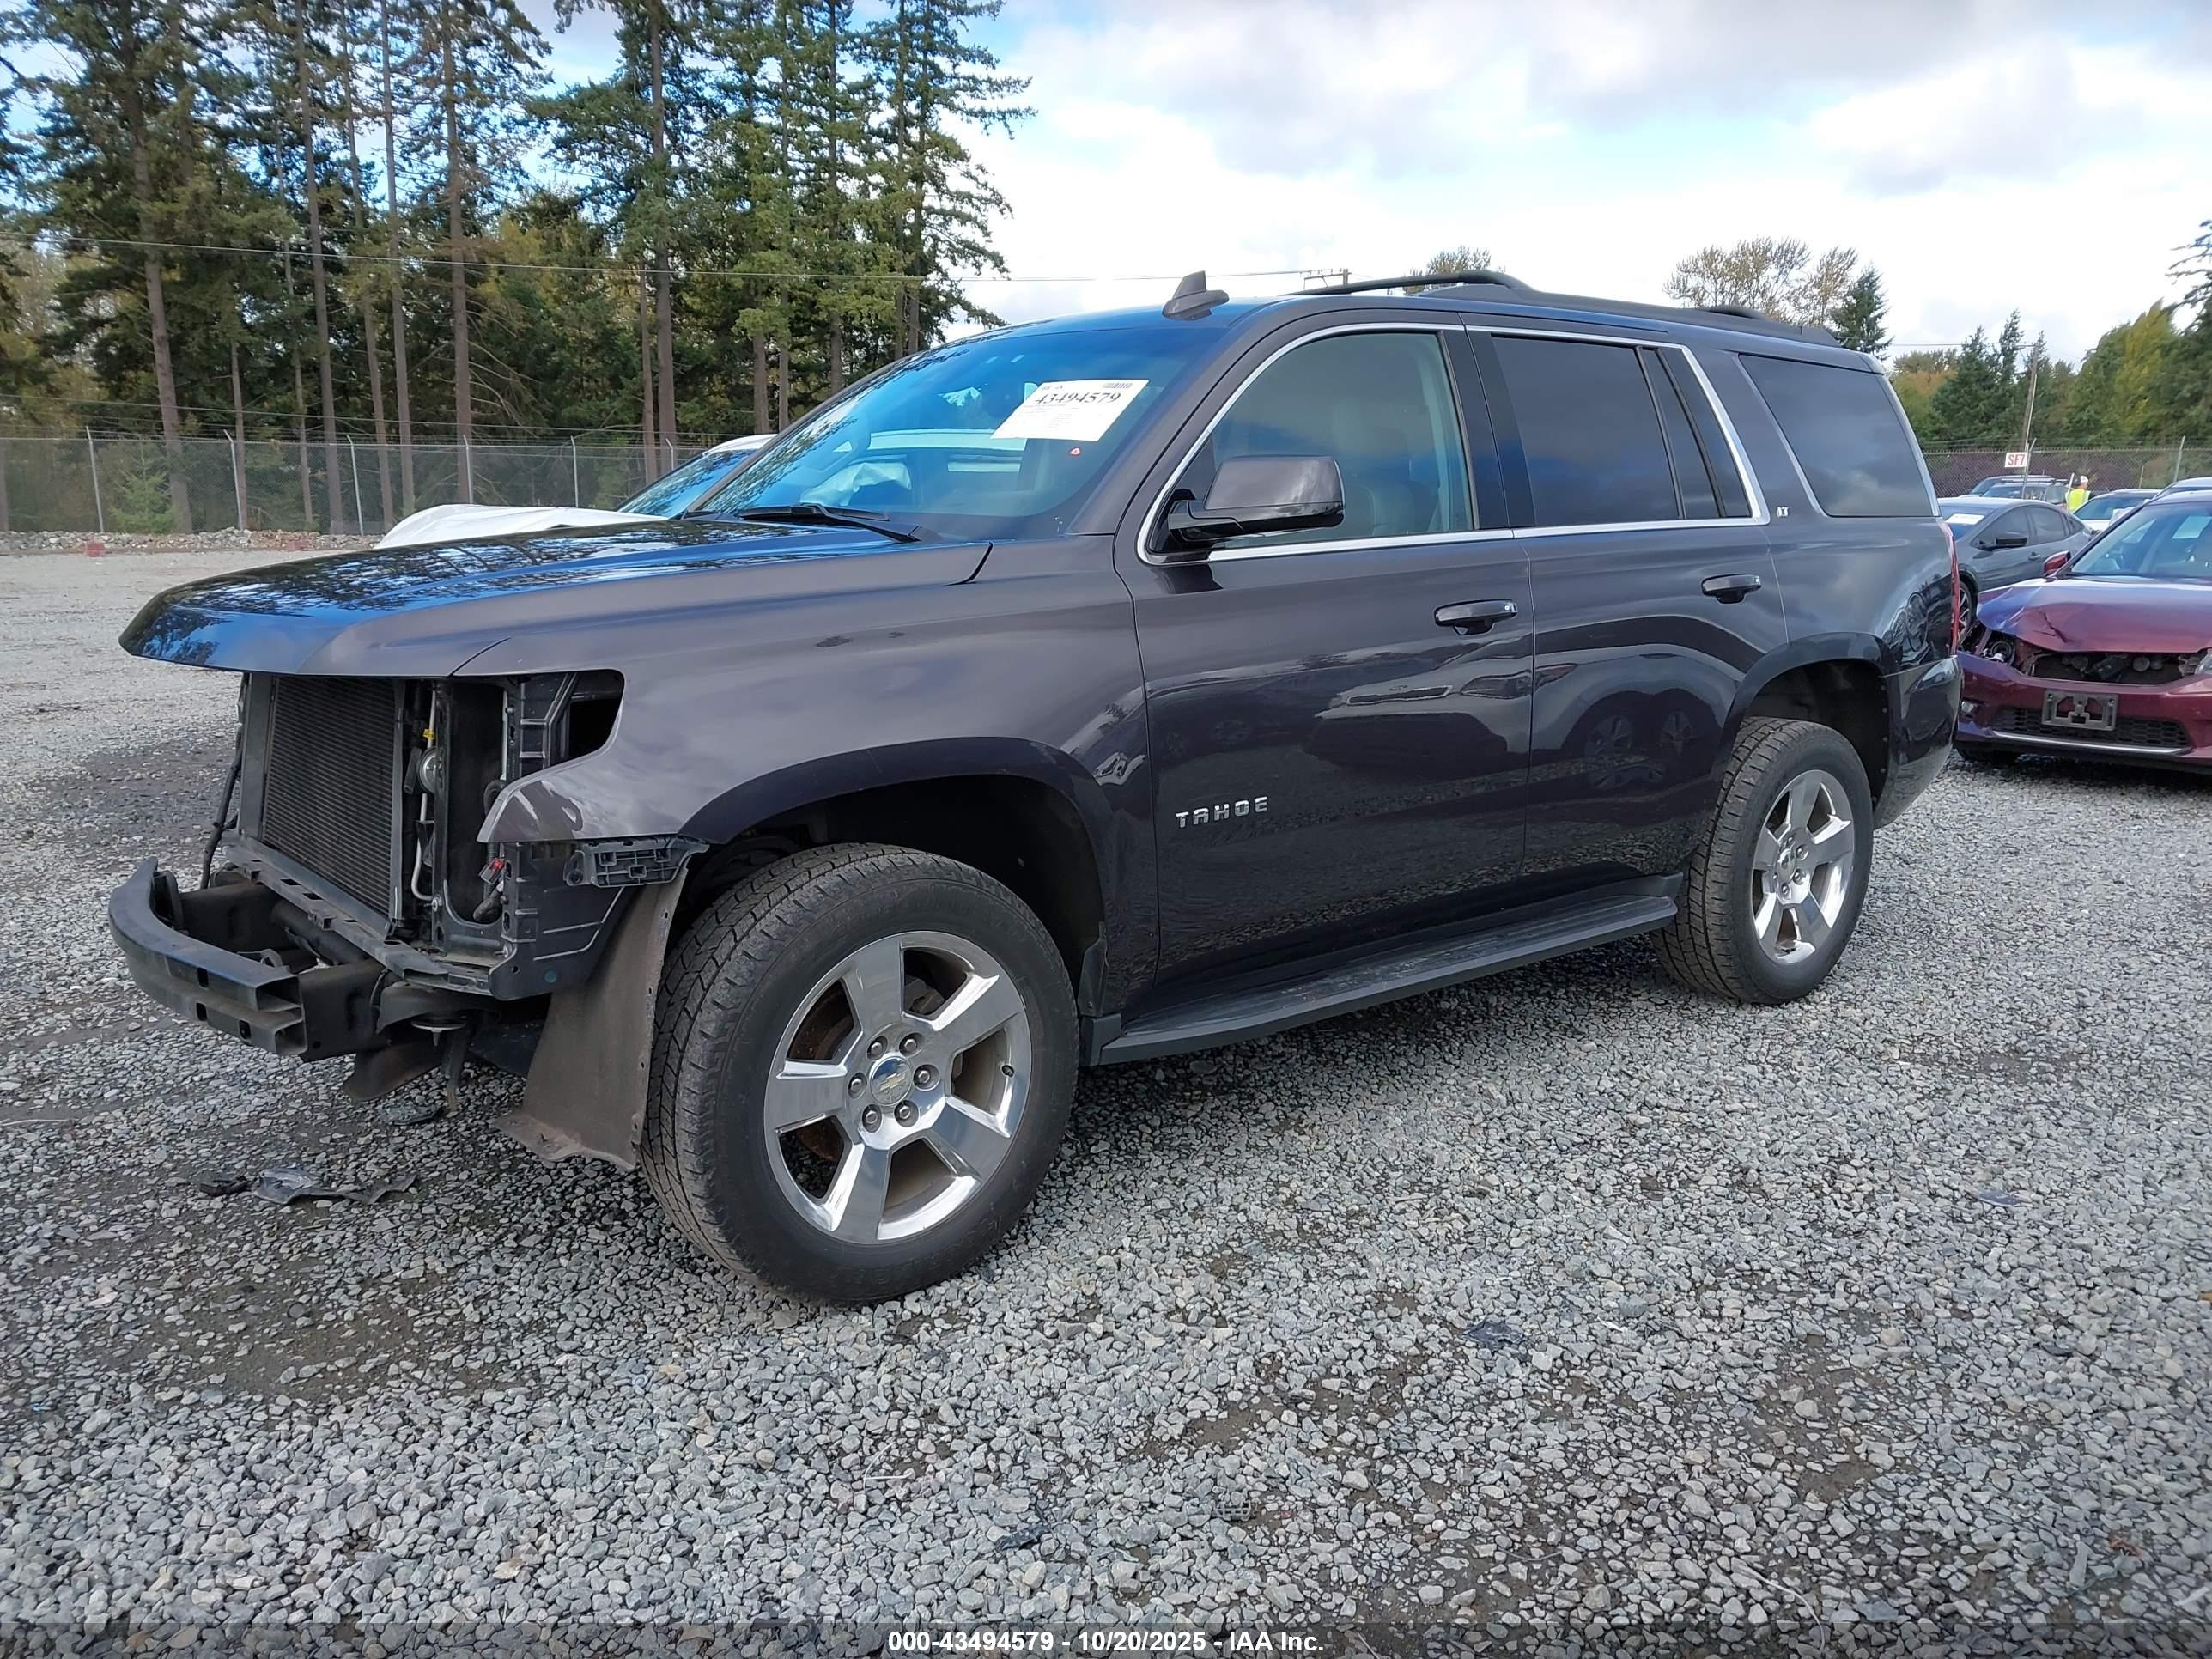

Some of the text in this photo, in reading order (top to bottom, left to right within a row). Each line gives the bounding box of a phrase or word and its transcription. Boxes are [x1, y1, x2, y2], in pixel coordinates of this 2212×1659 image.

[1035, 392, 1121, 404] 43494579
[2008, 453, 2026, 466] SF7
[1176, 796, 1268, 829] TAHOE
